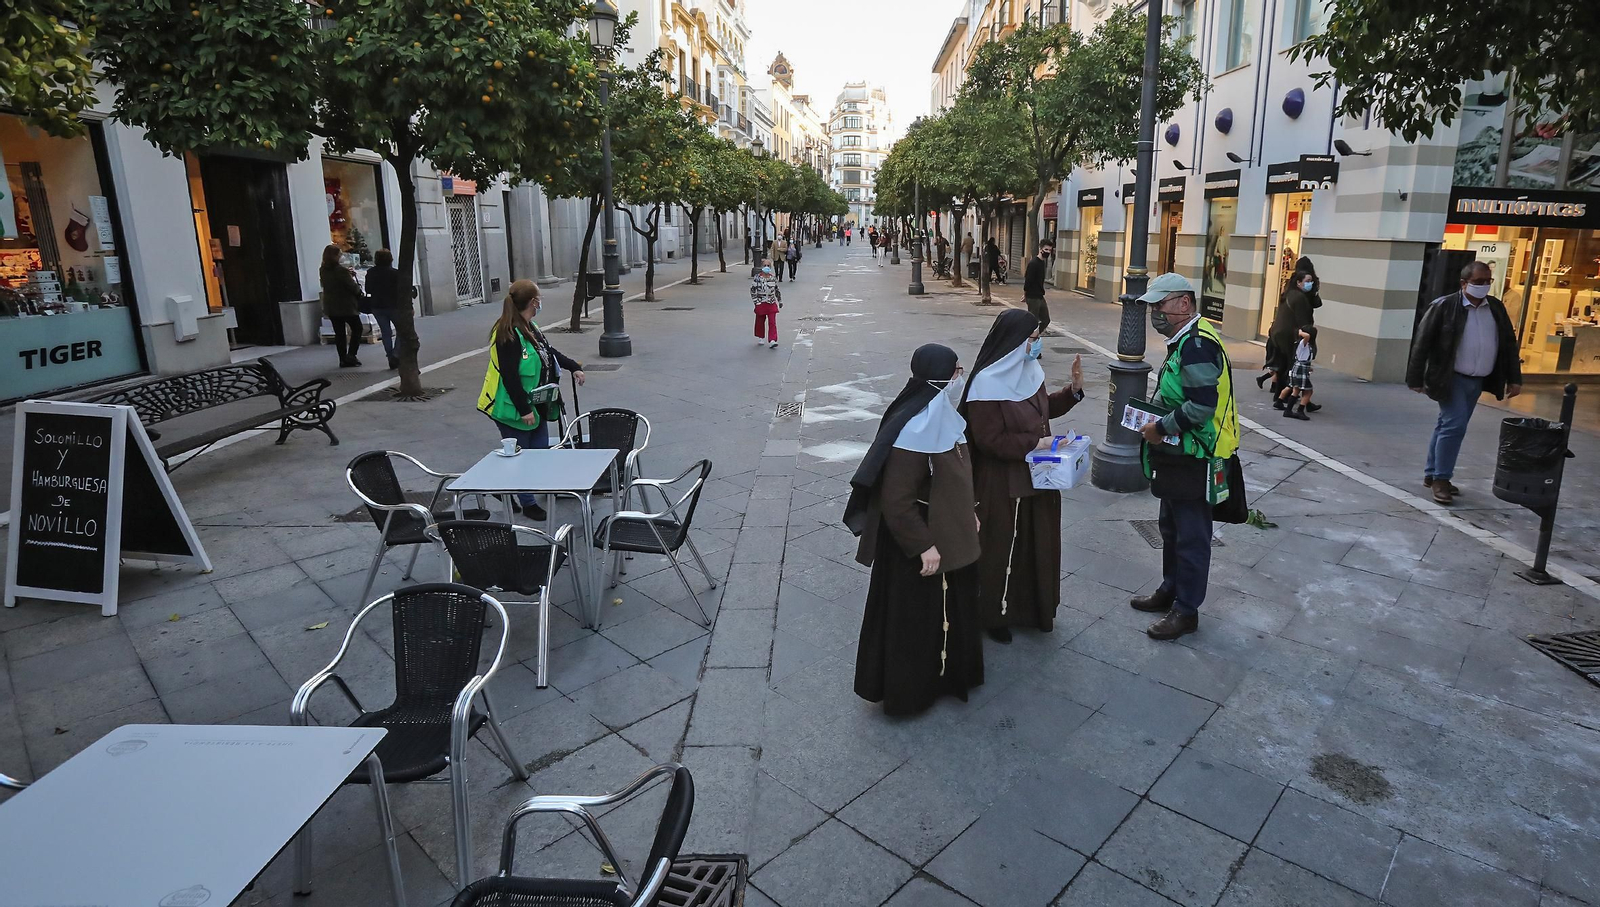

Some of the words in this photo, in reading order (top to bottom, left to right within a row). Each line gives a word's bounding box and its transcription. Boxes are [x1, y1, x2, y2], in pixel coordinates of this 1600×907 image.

[19, 340, 102, 370] TIGER
[57, 449, 68, 470] Y
[32, 470, 107, 494] HAMBURGUESA
[51, 495, 71, 507] DE
